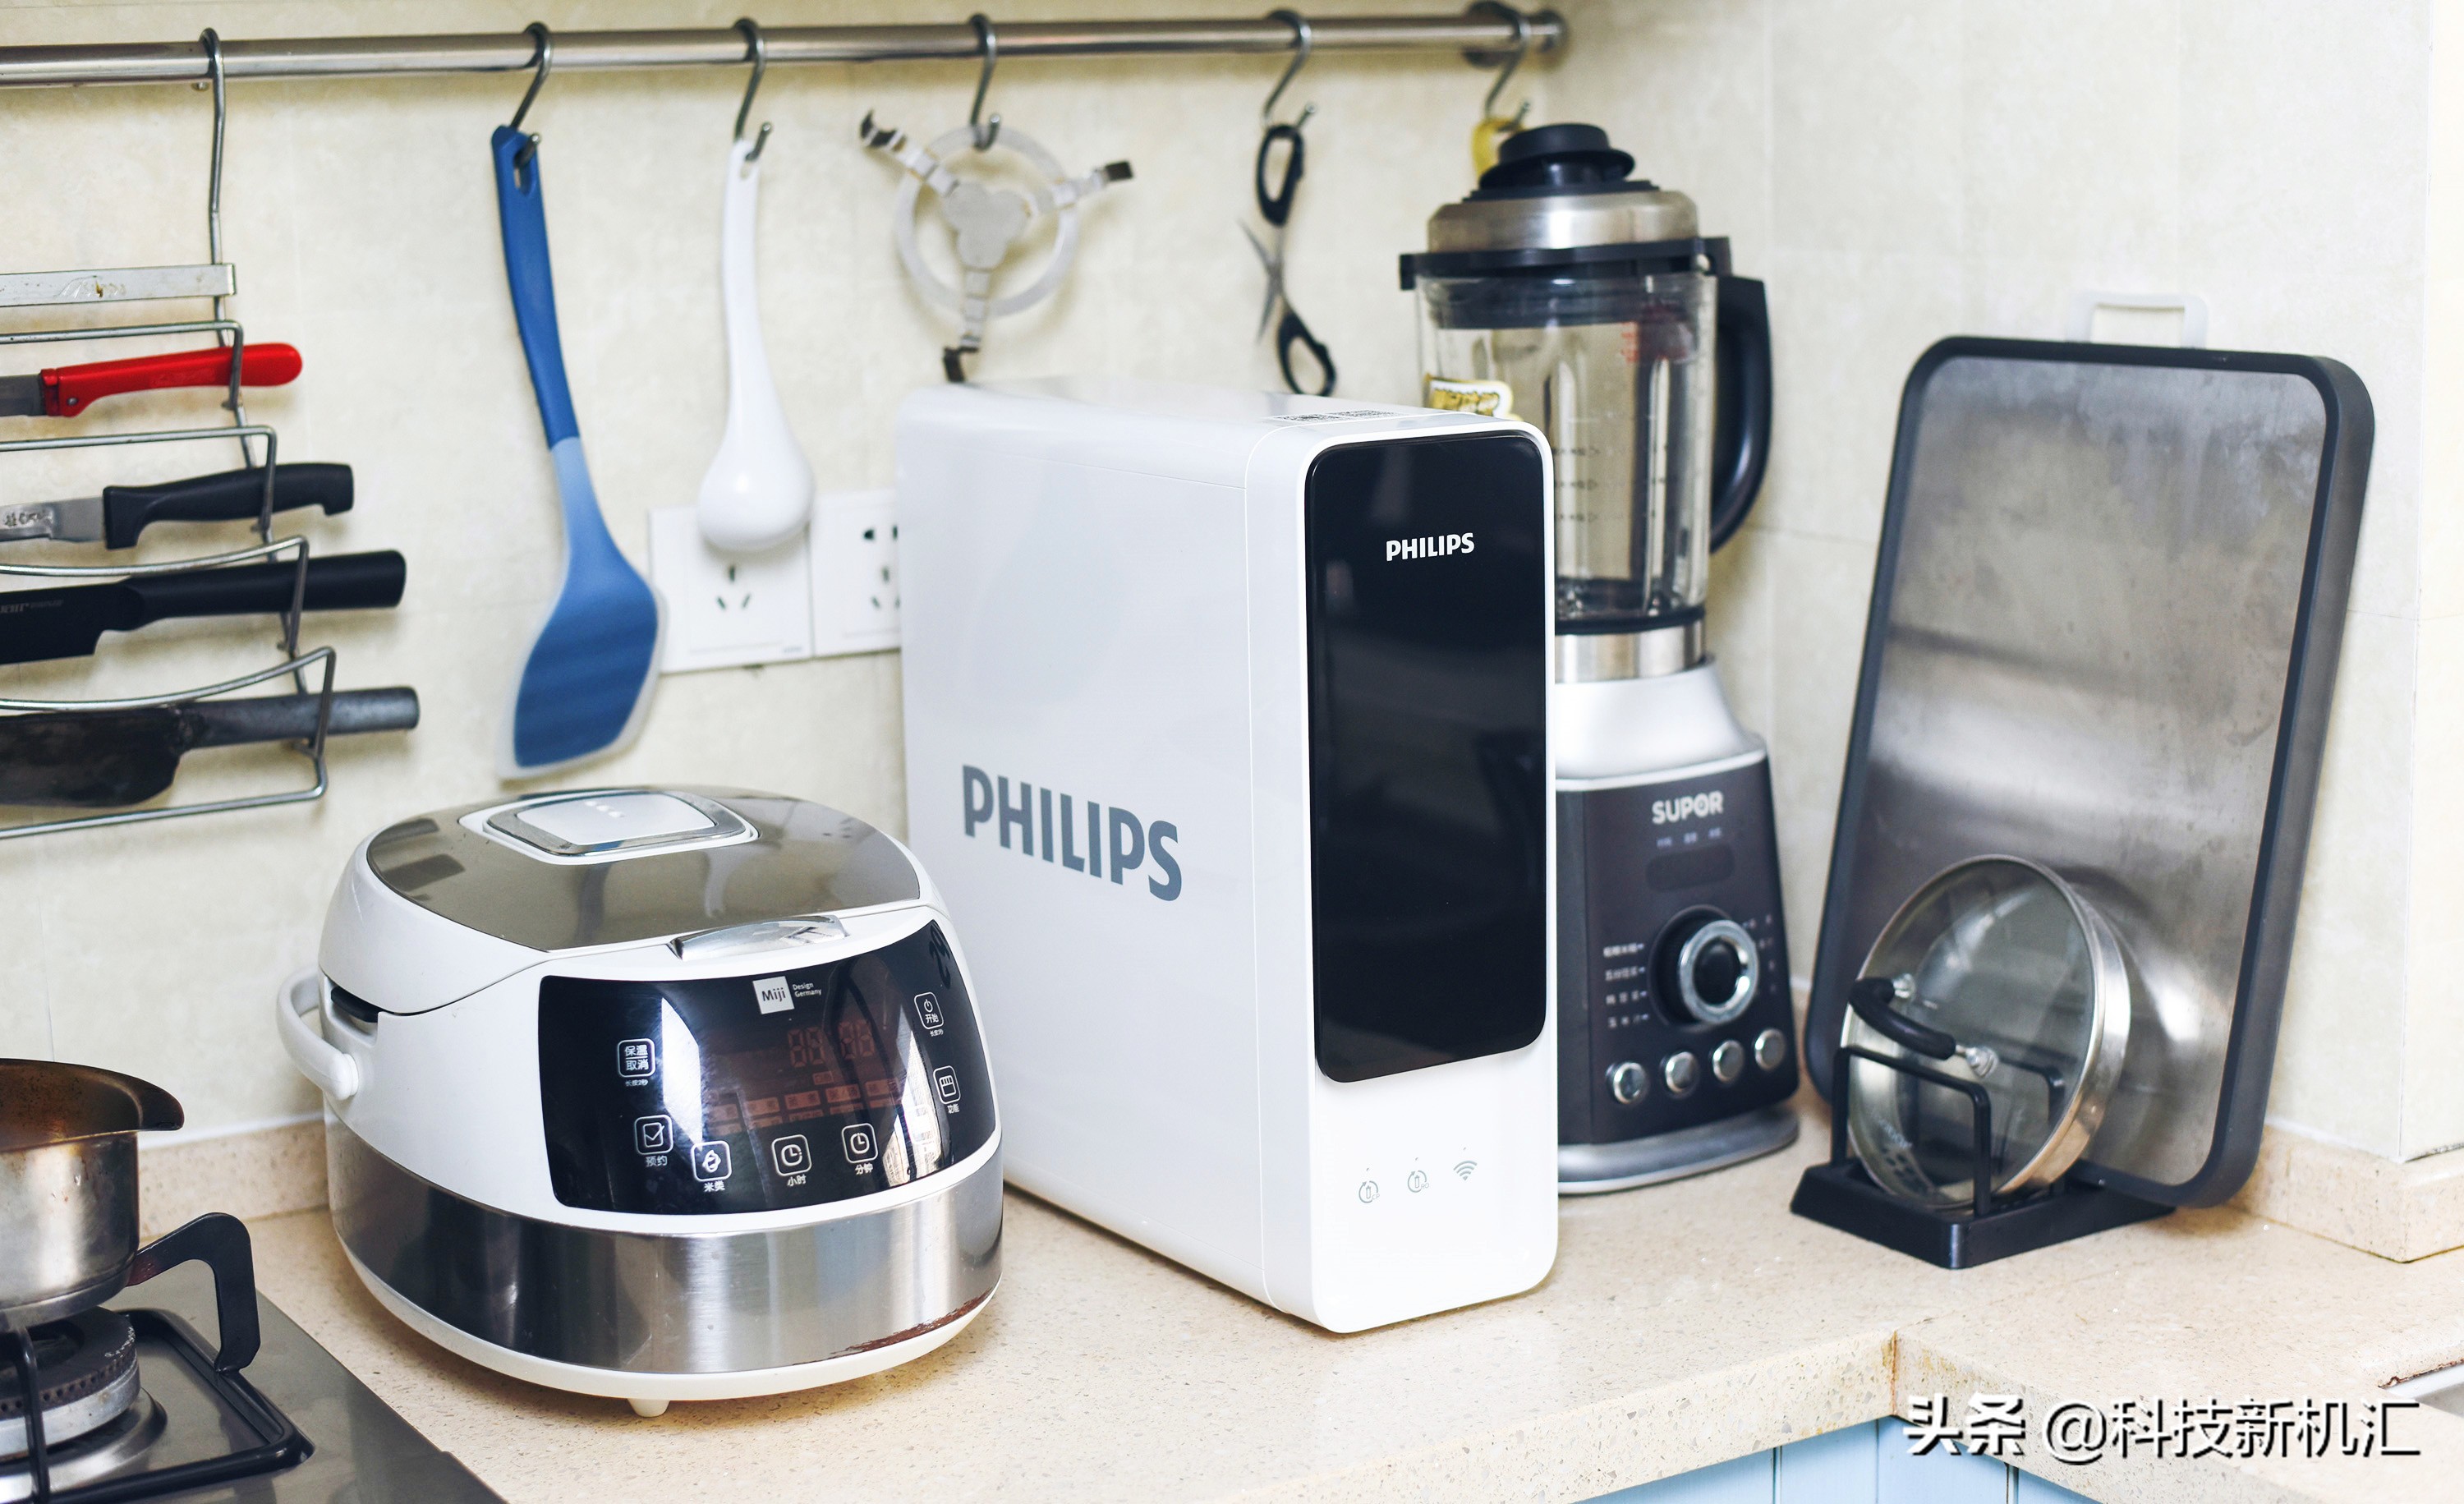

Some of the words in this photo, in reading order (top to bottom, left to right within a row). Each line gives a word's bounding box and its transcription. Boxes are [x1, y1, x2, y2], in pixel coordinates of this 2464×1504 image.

[1386, 532, 1475, 562] PHILIPS
[1652, 791, 1724, 825] SUPOR
[962, 764, 1182, 902] PHILIPS
[792, 982, 814, 991] Design
[761, 987, 786, 1002] Miji
[794, 989, 822, 998] Germany
[925, 1013, 940, 1023] 开始
[625, 1044, 649, 1056] 保温
[626, 1059, 650, 1070] 取消
[646, 1155, 668, 1167] 预约
[855, 1163, 873, 1175] 分钟
[704, 1180, 725, 1193] 米类
[787, 1175, 807, 1186] 小时
